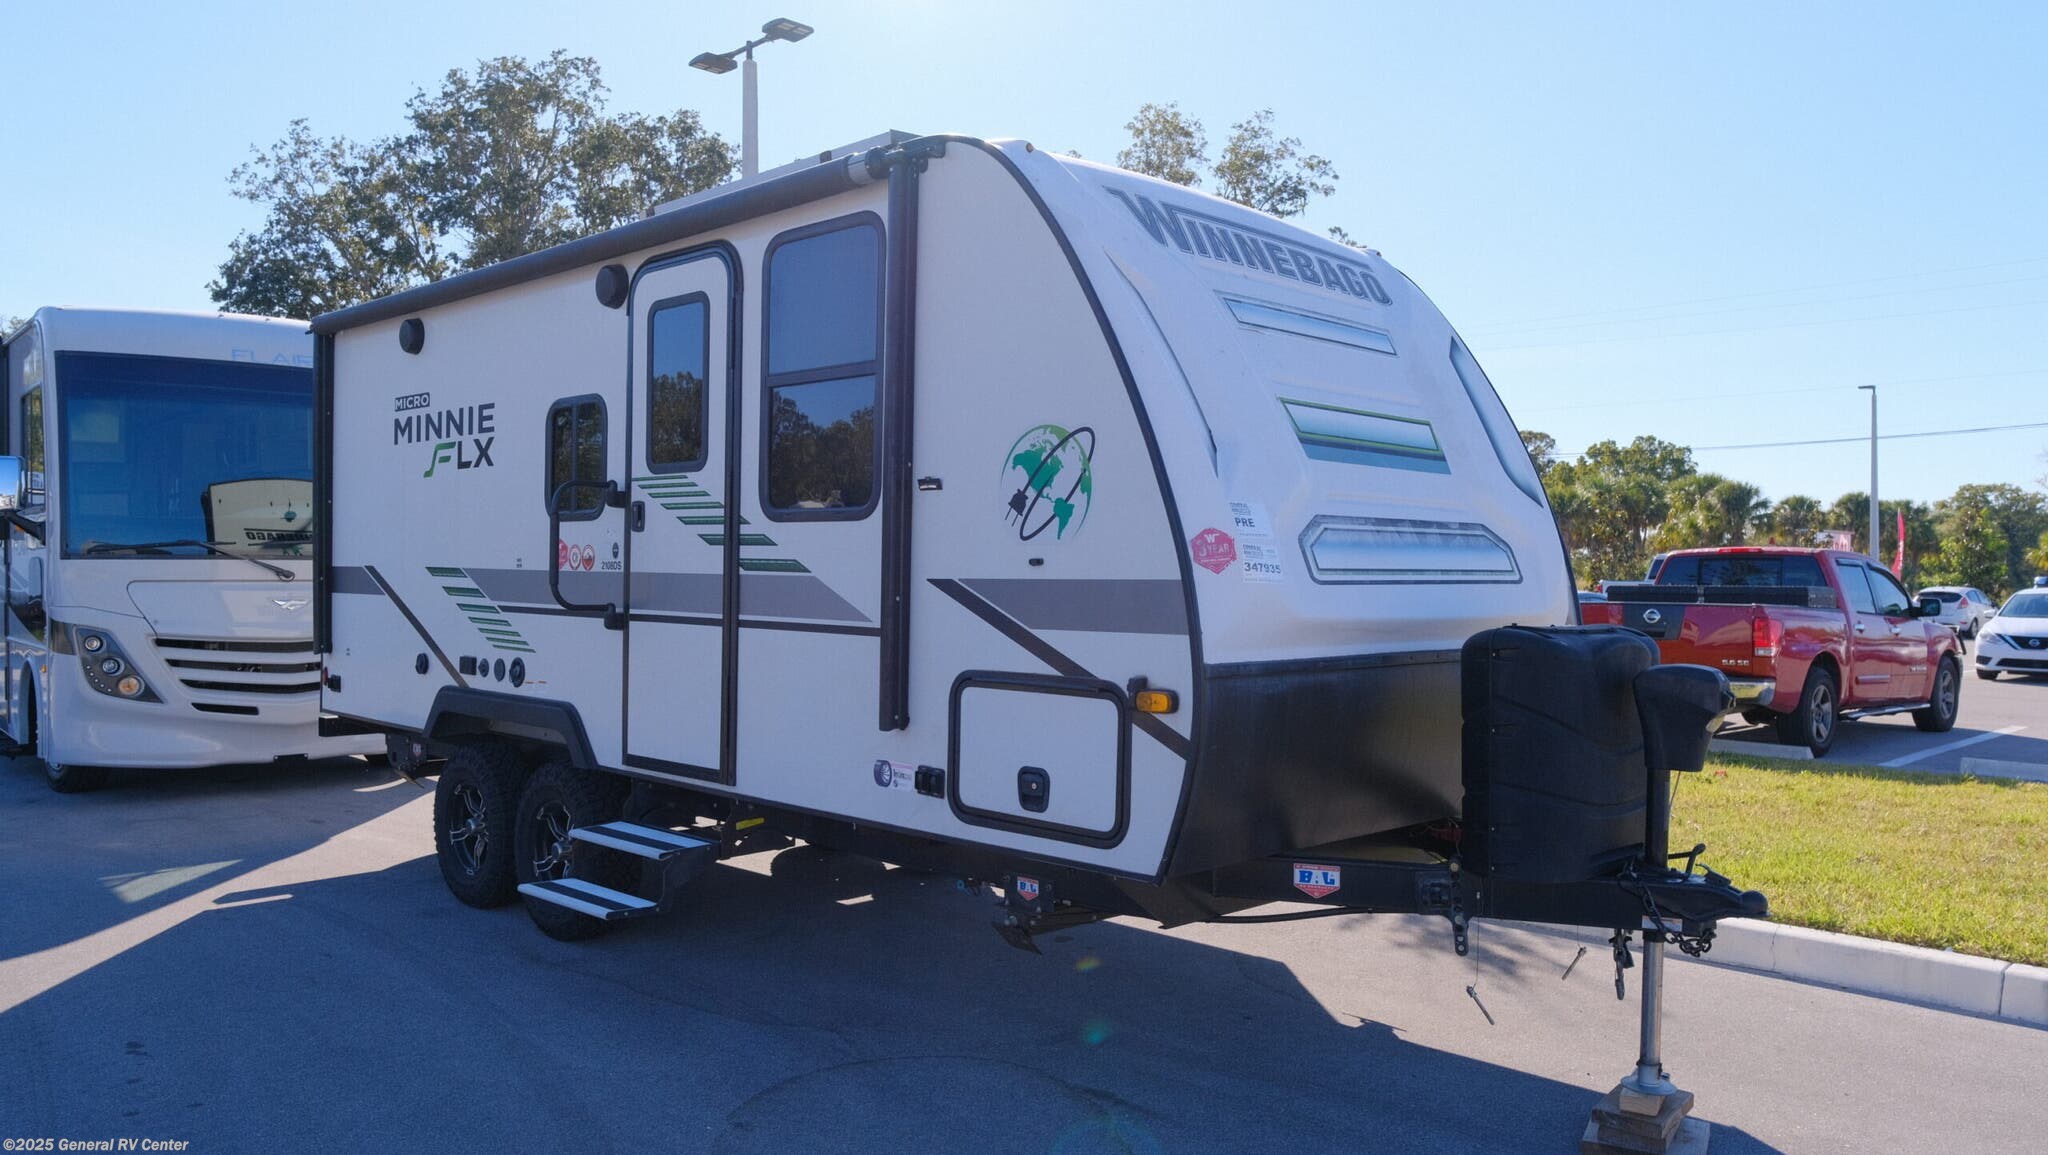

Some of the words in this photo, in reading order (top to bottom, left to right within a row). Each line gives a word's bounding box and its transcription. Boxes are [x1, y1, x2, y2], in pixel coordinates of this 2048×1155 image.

[1102, 185, 1393, 306] WINNEBAGO
[395, 394, 430, 411] MICRO
[394, 403, 495, 445] MINNIE
[423, 436, 495, 478] FLX
[1234, 517, 1256, 528] PRE
[1244, 562, 1281, 574] 347935
